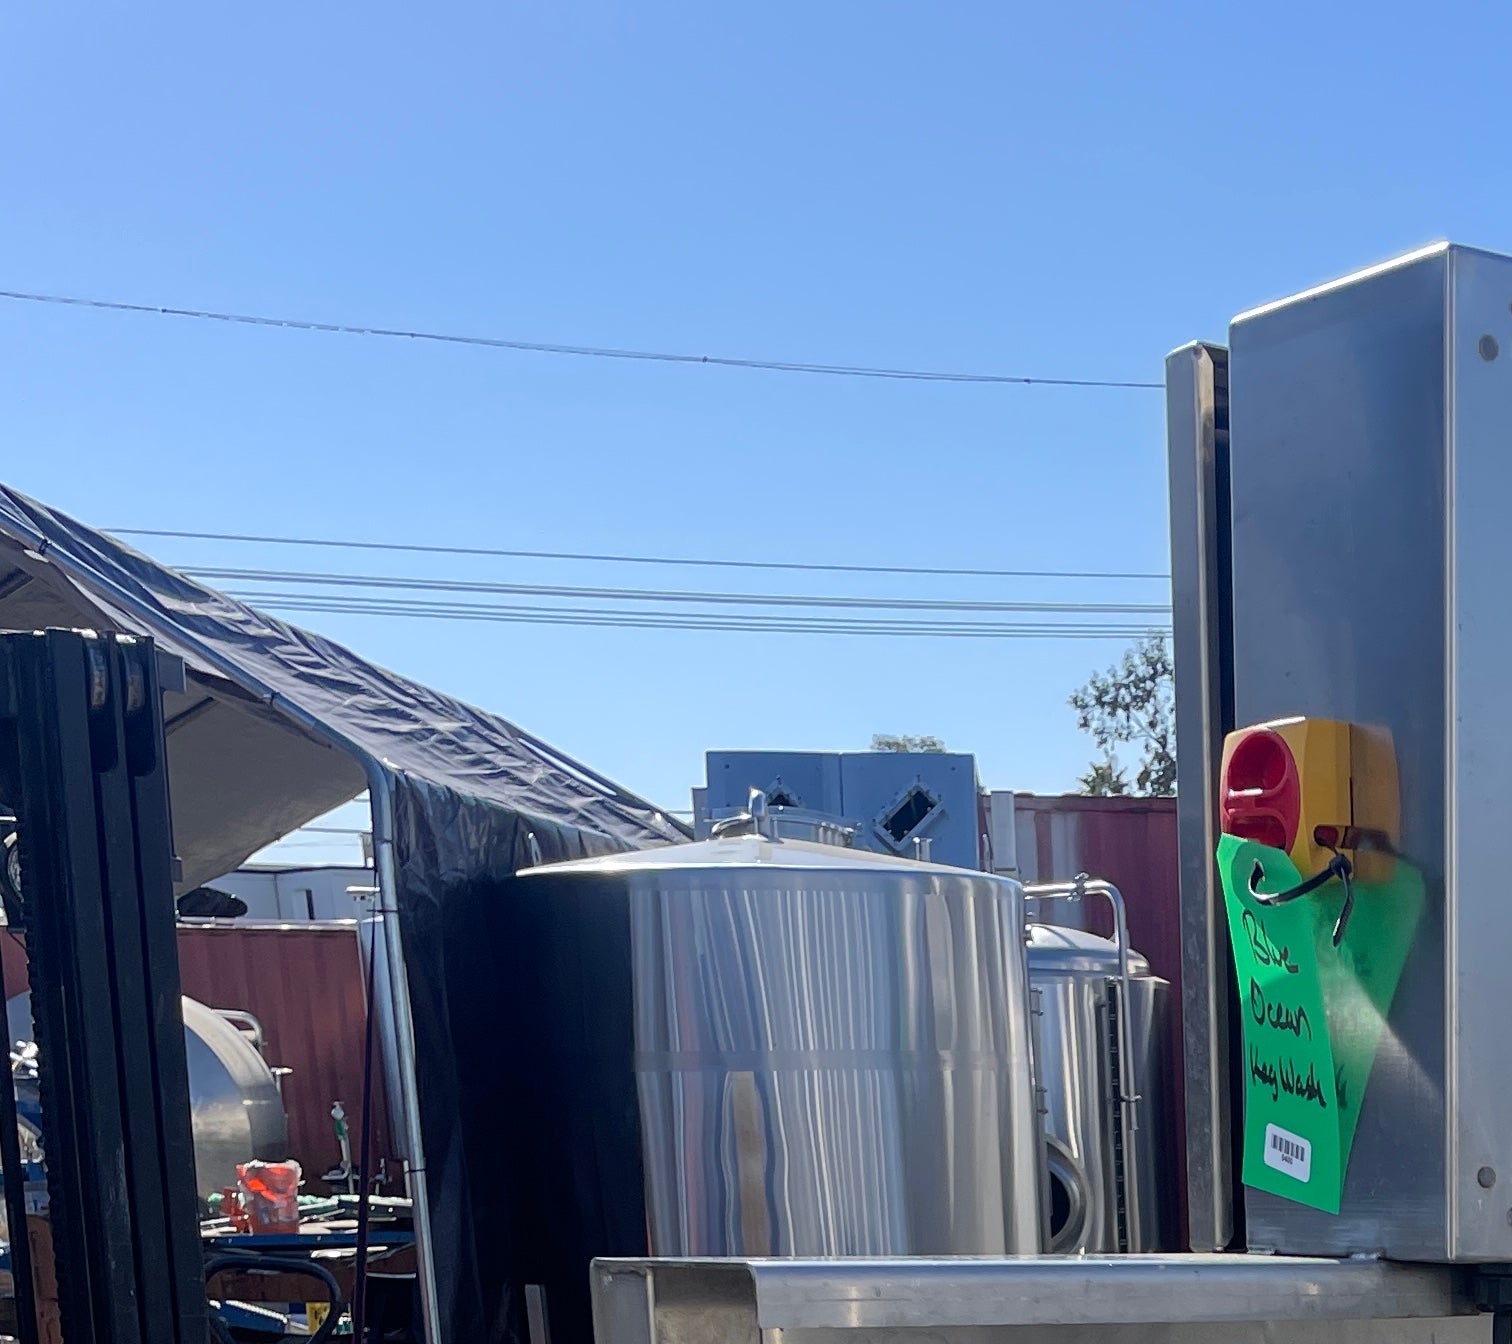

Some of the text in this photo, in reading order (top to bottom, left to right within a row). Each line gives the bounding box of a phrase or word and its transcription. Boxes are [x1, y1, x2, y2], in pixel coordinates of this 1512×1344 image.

[1242, 909, 1299, 974] Blue
[1250, 977, 1312, 1041] Ocean
[1279, 1056, 1327, 1109] Wash
